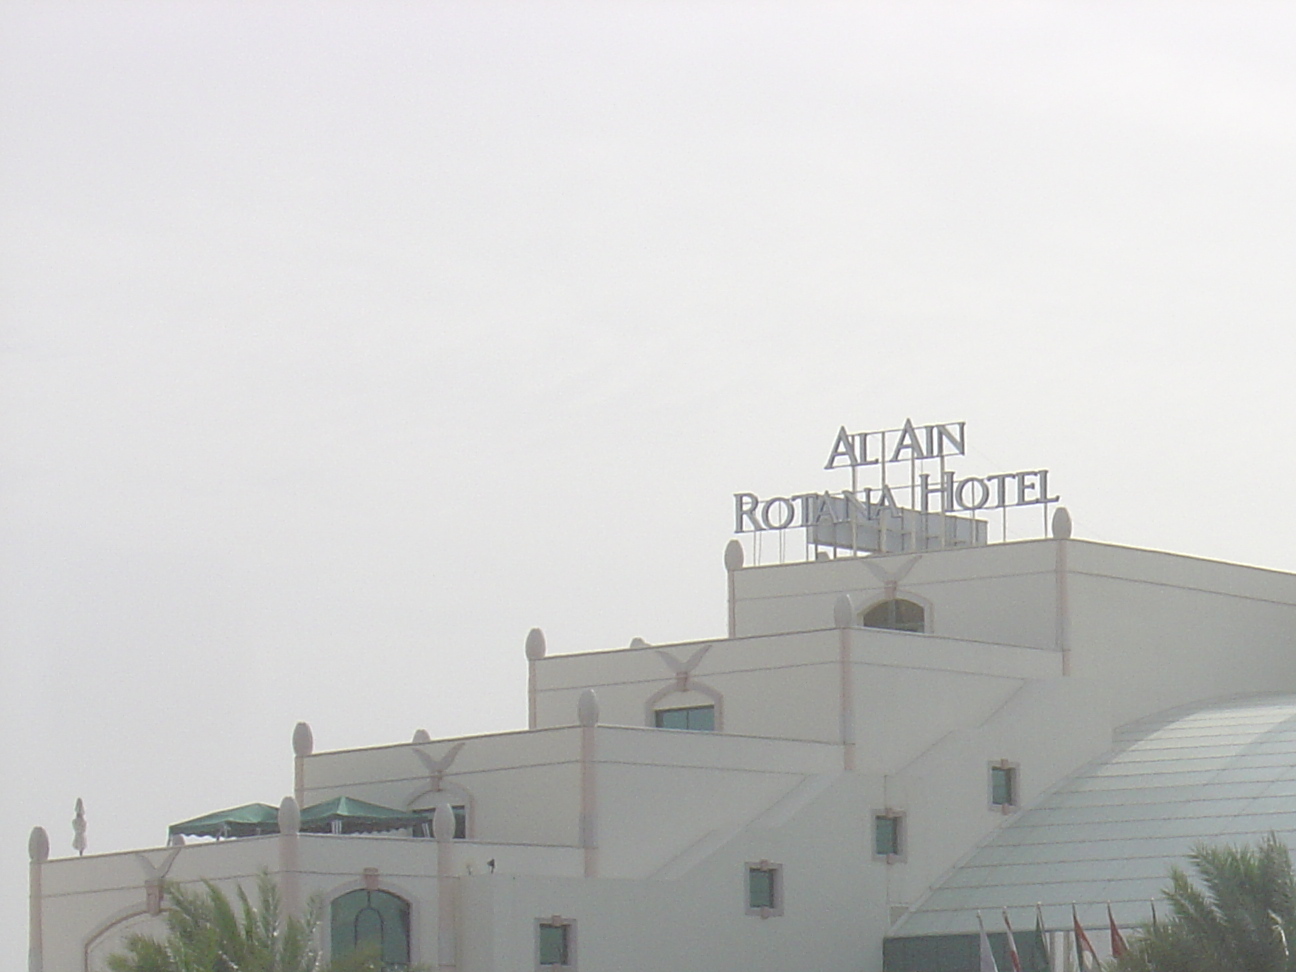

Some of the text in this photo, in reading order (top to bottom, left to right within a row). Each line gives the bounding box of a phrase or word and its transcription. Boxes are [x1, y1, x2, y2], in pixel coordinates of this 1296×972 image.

[824, 417, 966, 470] AL AIN
[733, 469, 1060, 534] ROTANA HOTEL
